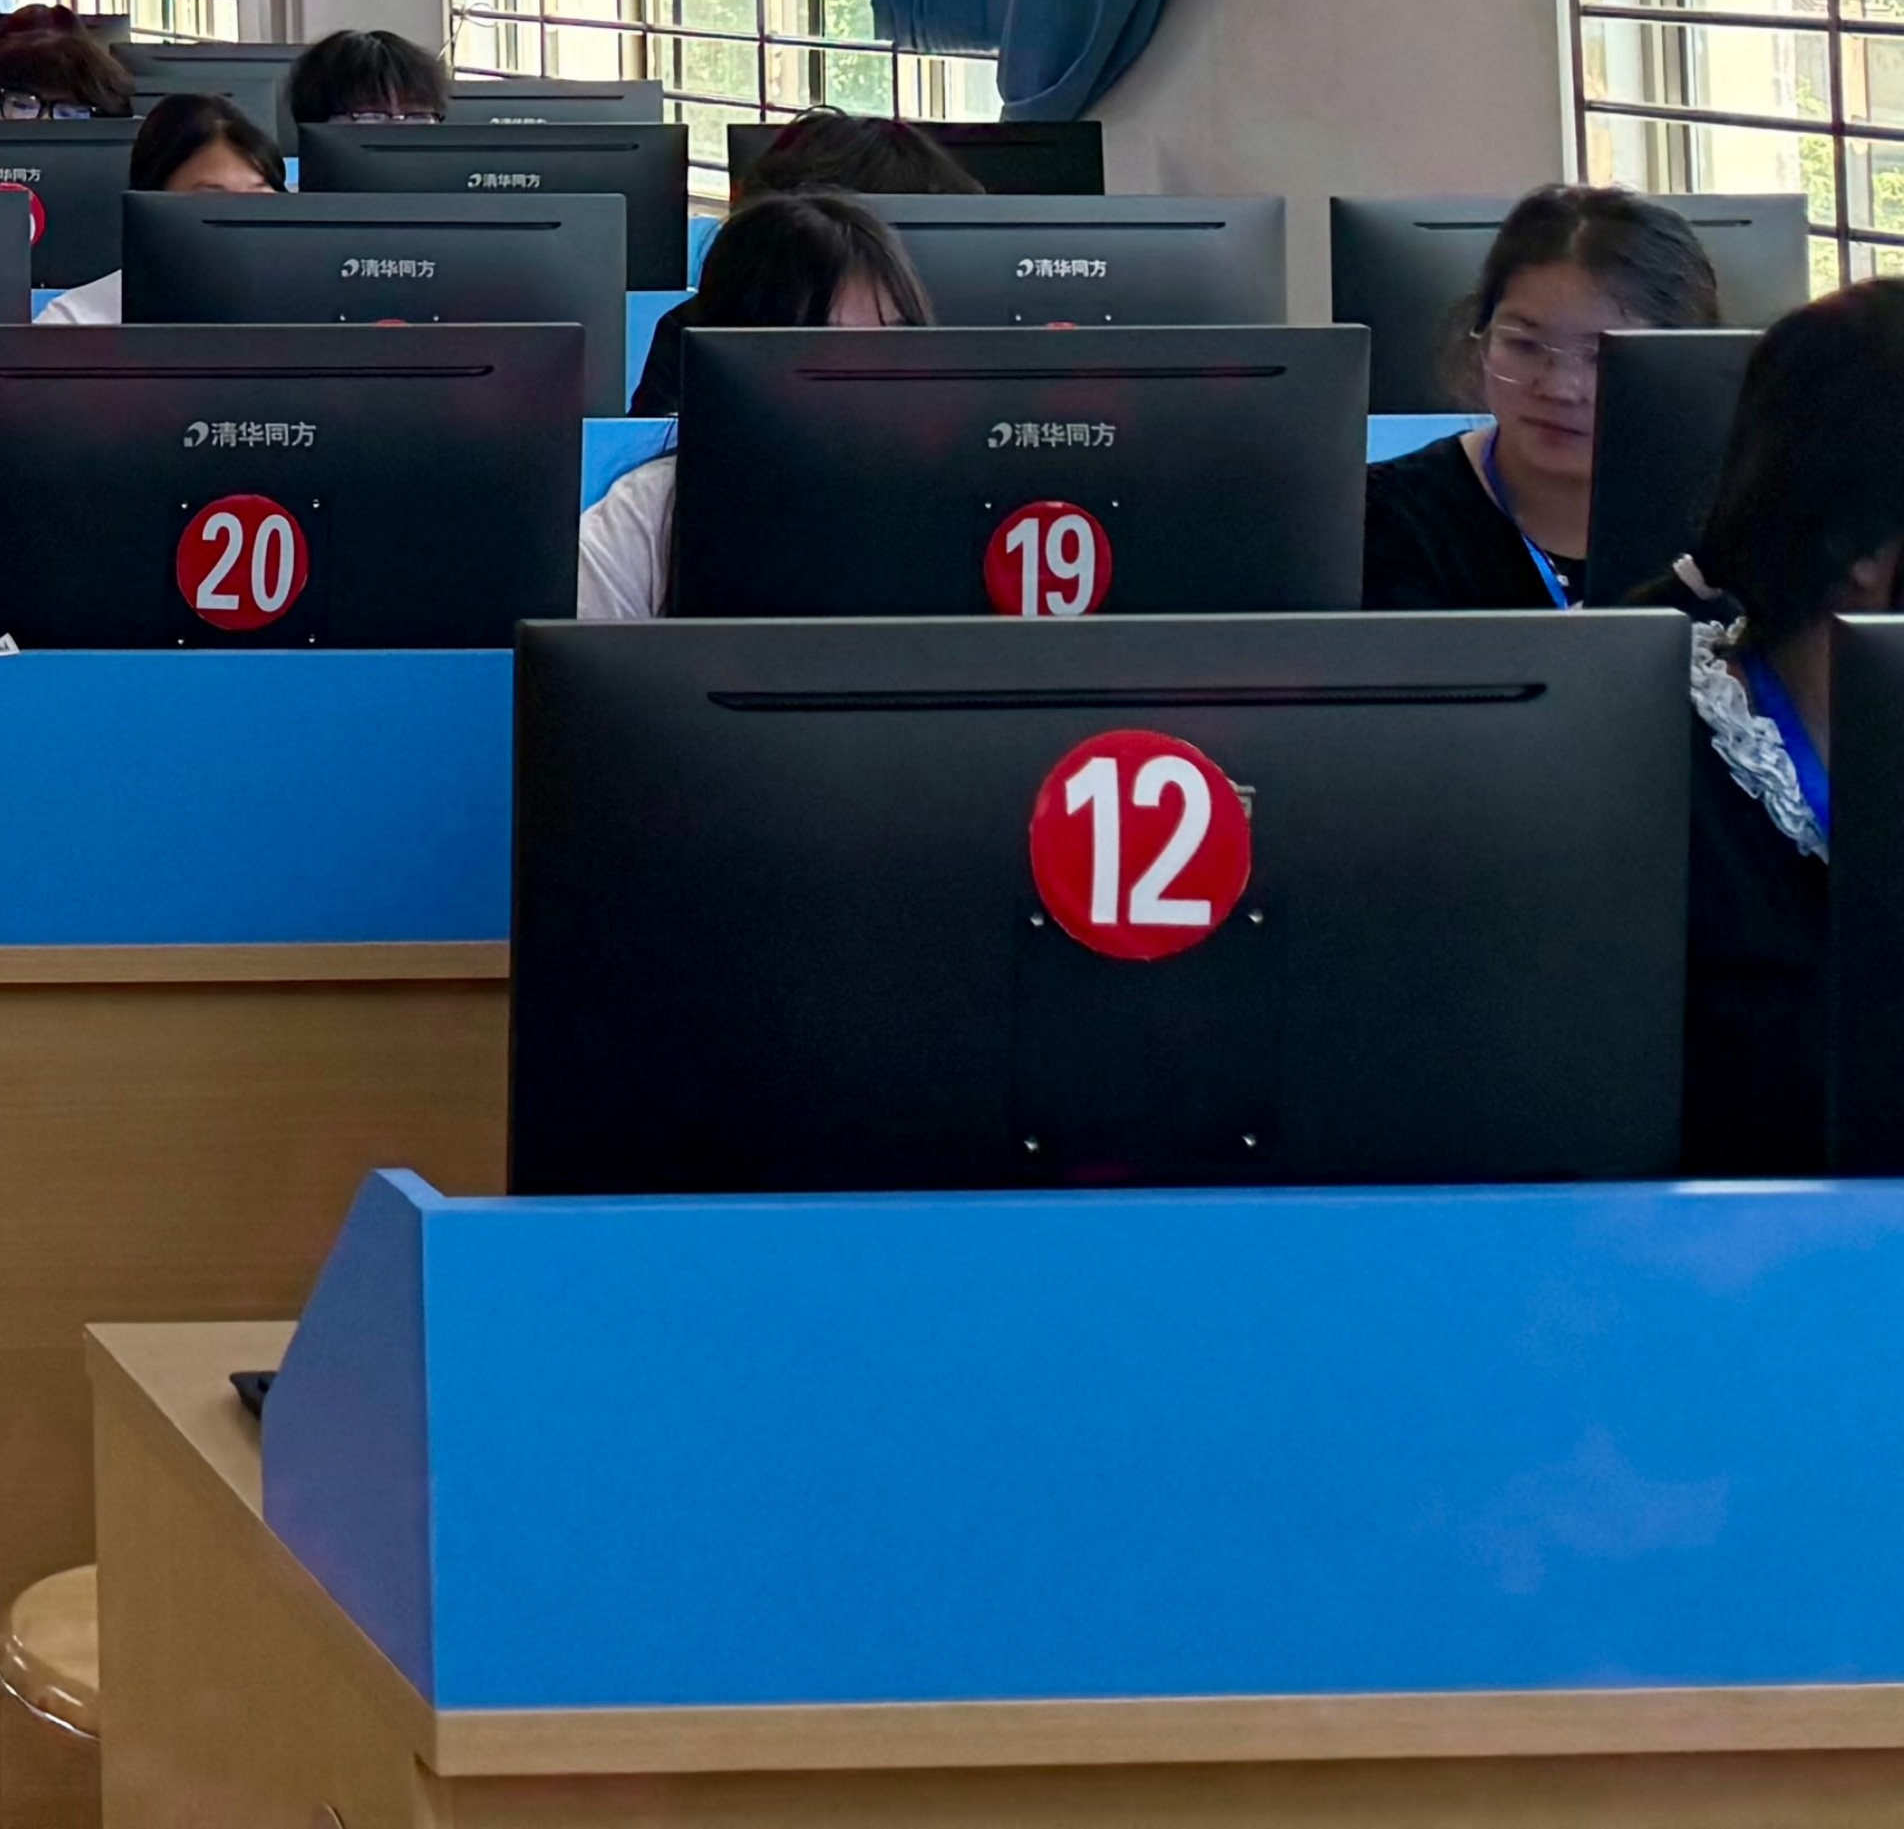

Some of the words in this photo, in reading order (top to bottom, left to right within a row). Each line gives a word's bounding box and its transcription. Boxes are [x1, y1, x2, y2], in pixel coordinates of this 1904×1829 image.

[483, 173, 540, 188] 清华同方
[360, 258, 436, 278] 清华同方
[1034, 258, 1108, 278] 清华同方
[211, 421, 317, 448] 清华同方
[1014, 422, 1116, 449] 清华同方
[195, 512, 295, 613] 20
[1006, 514, 1095, 616] 19
[1065, 755, 1212, 926] 12
